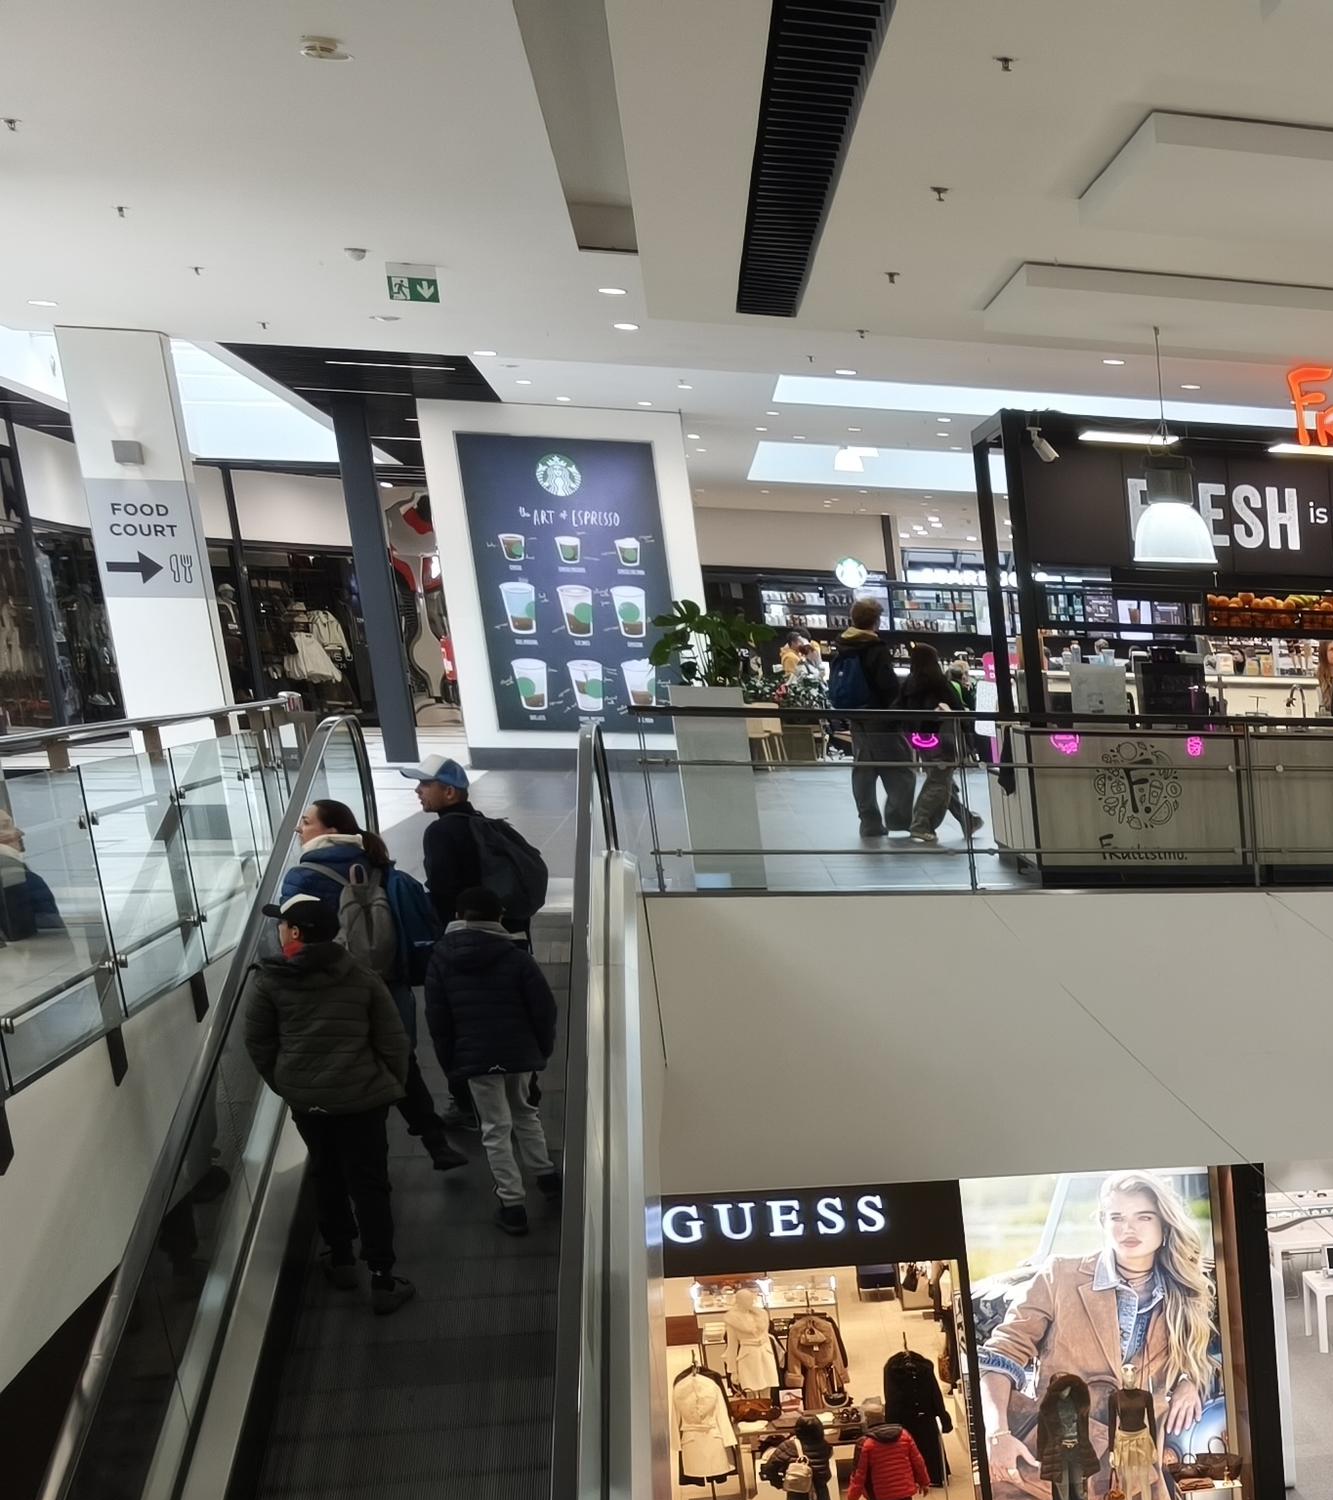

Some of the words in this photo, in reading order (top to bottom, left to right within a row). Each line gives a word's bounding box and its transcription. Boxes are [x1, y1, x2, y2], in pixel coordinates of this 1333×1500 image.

[110, 503, 169, 516] FOOD
[533, 509, 555, 525] ART
[571, 509, 620, 527] ESPRESSO
[1127, 477, 1300, 552] FESH
[1308, 502, 1328, 525] is
[110, 523, 177, 537] COURT
[662, 1195, 886, 1243] GUESS
